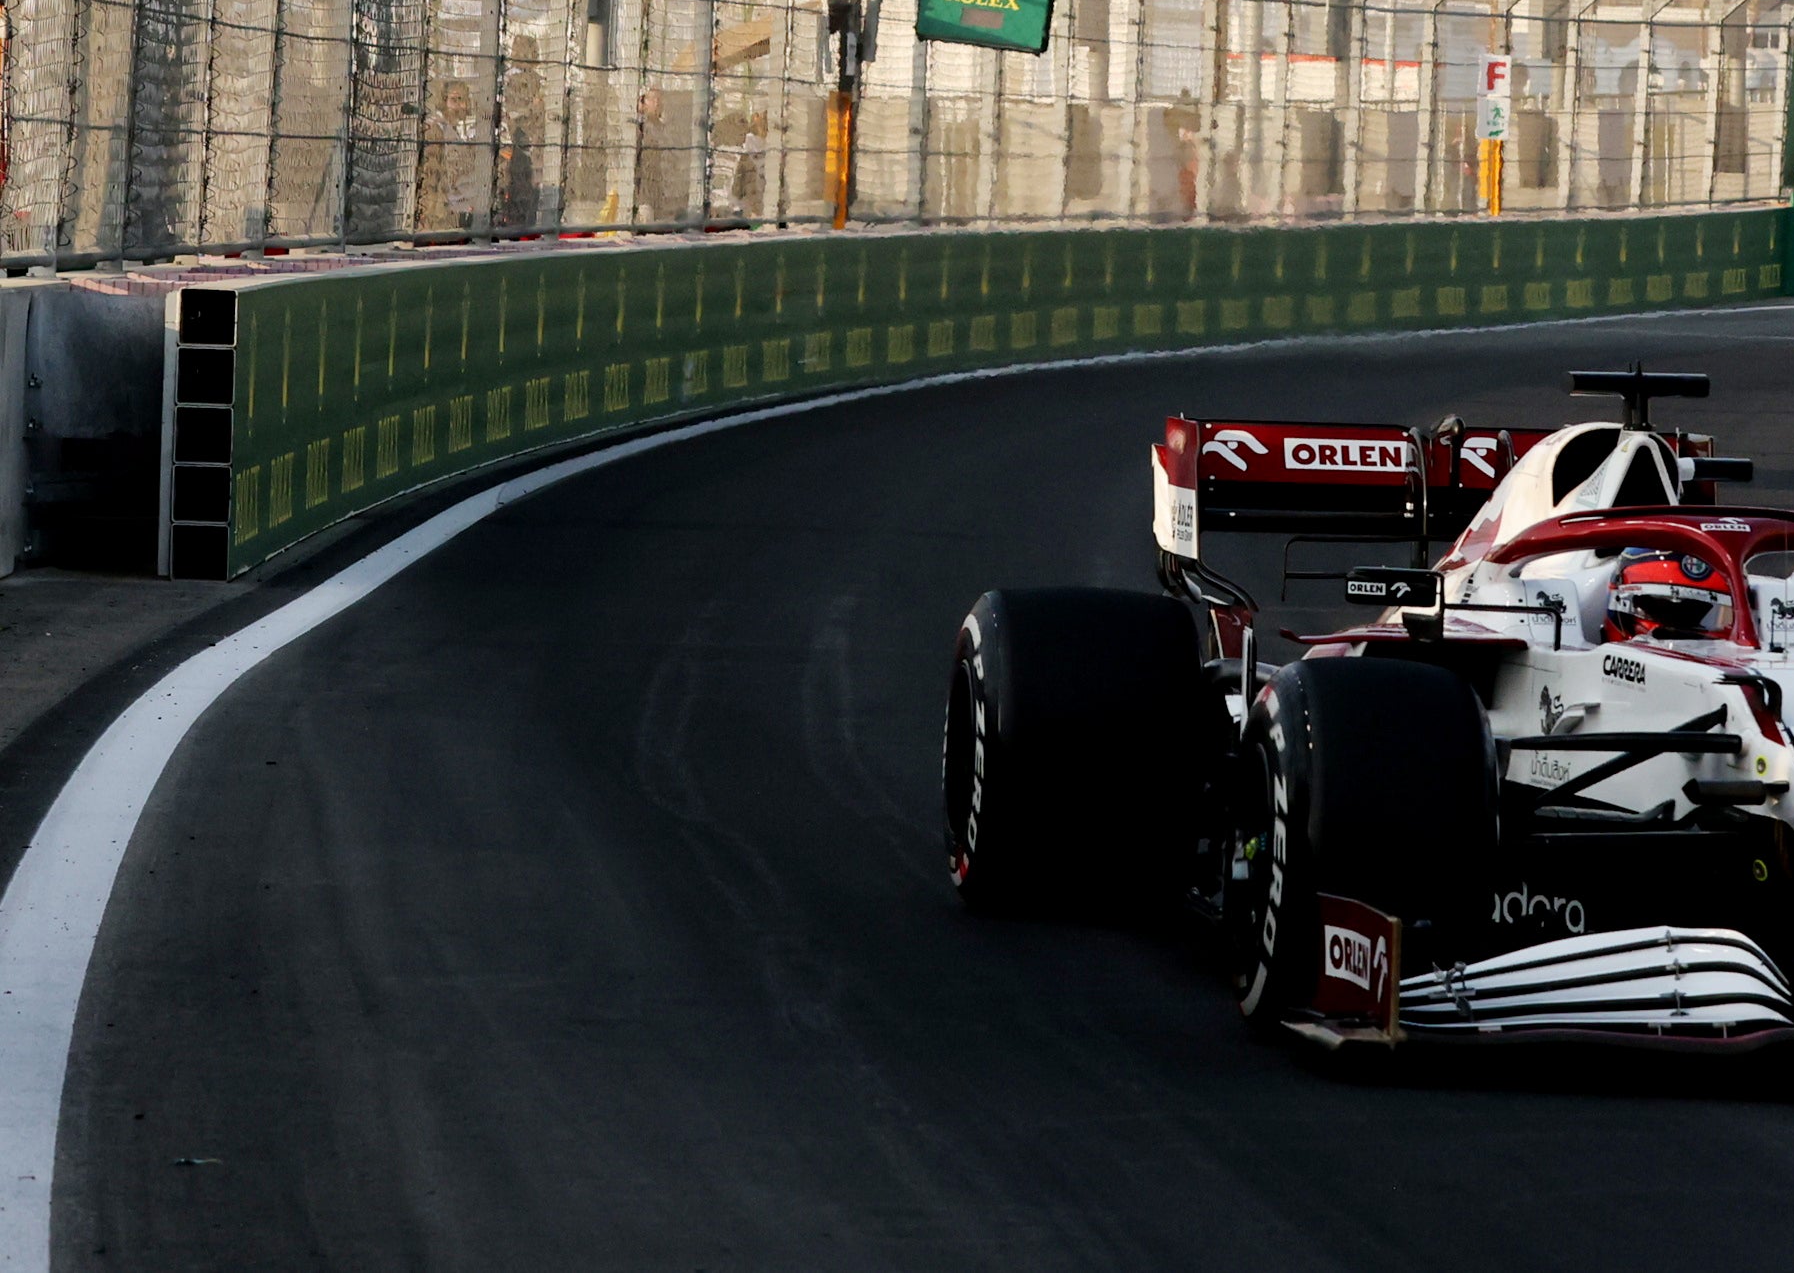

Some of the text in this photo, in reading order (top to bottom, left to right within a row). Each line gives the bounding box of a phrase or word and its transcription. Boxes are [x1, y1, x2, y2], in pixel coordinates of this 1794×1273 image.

[1487, 61, 1506, 91] F
[1291, 443, 1402, 468] ORLEN
[1350, 583, 1384, 594] ORLEN
[1603, 654, 1646, 686] CARRERA
[968, 700, 986, 853] ZERO
[1262, 722, 1288, 958] P ZERO
[1329, 933, 1369, 982] ORLEN
